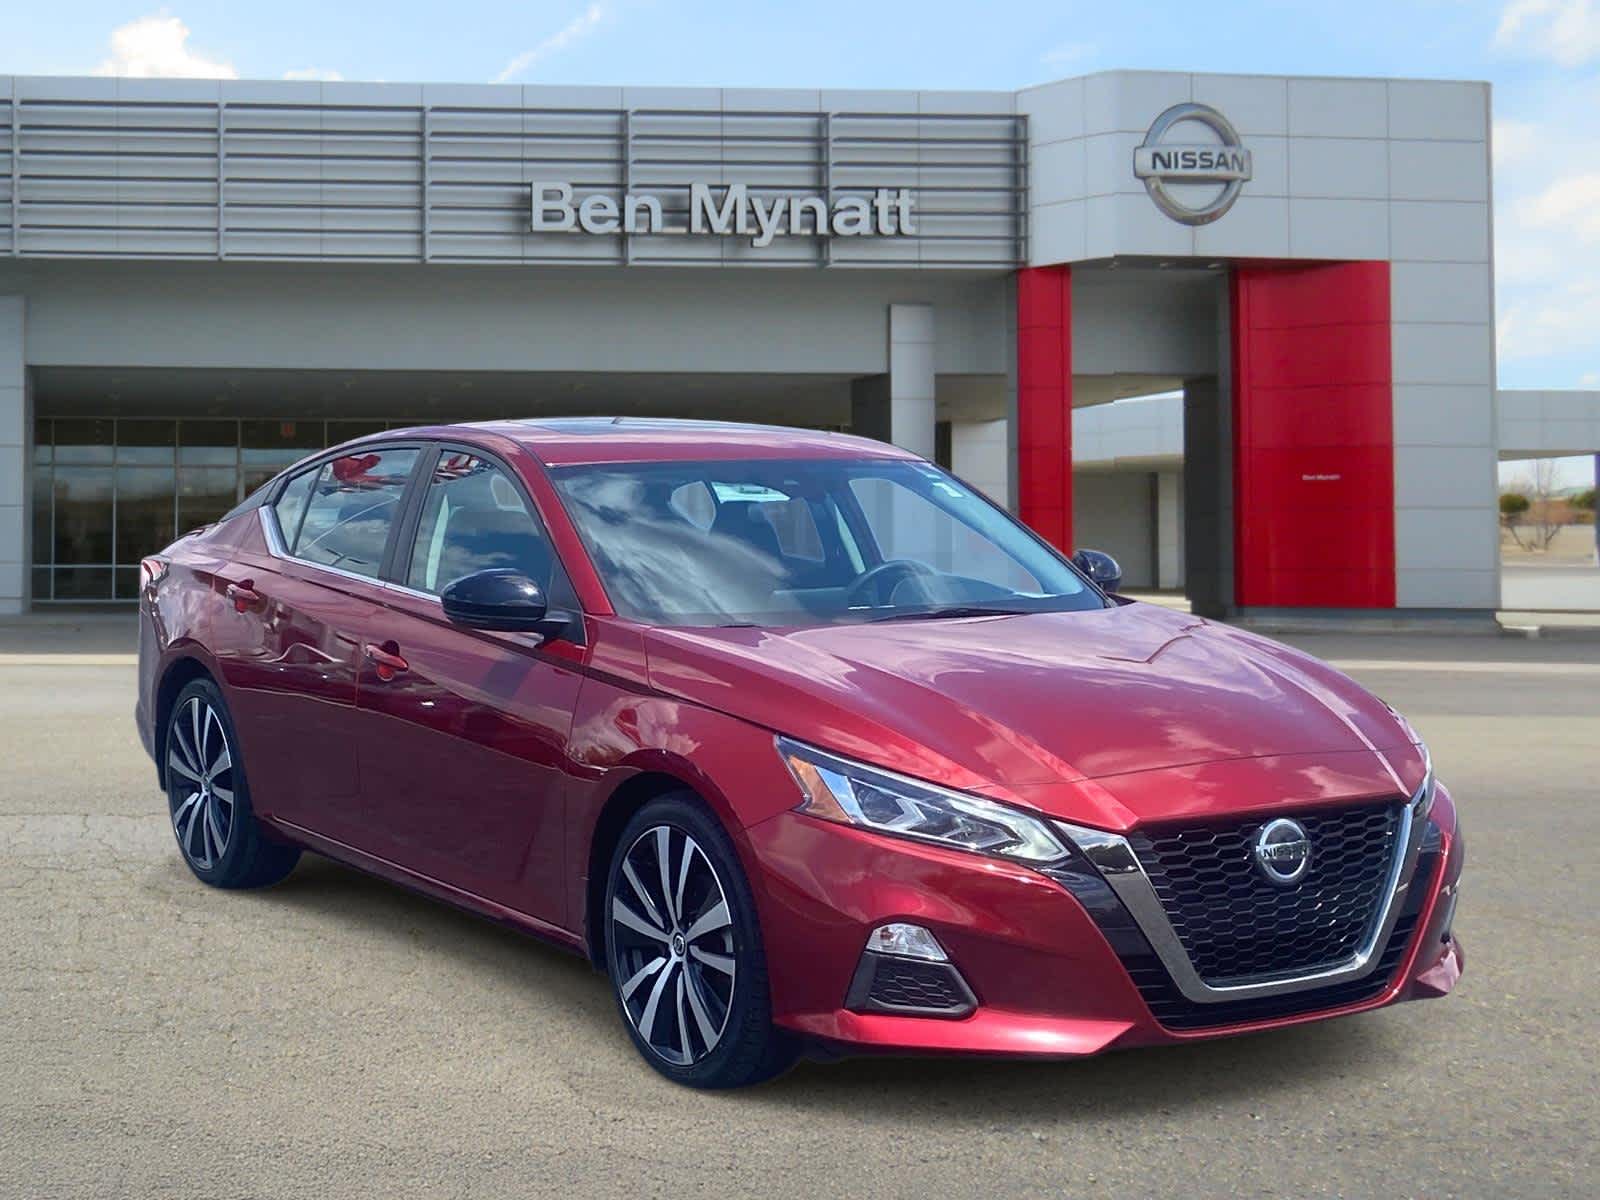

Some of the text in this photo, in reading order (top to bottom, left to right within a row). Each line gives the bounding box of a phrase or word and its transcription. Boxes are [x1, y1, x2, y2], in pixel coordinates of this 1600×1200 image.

[1151, 151, 1245, 172] NISSAN
[530, 181, 917, 248] Ben Mynatt
